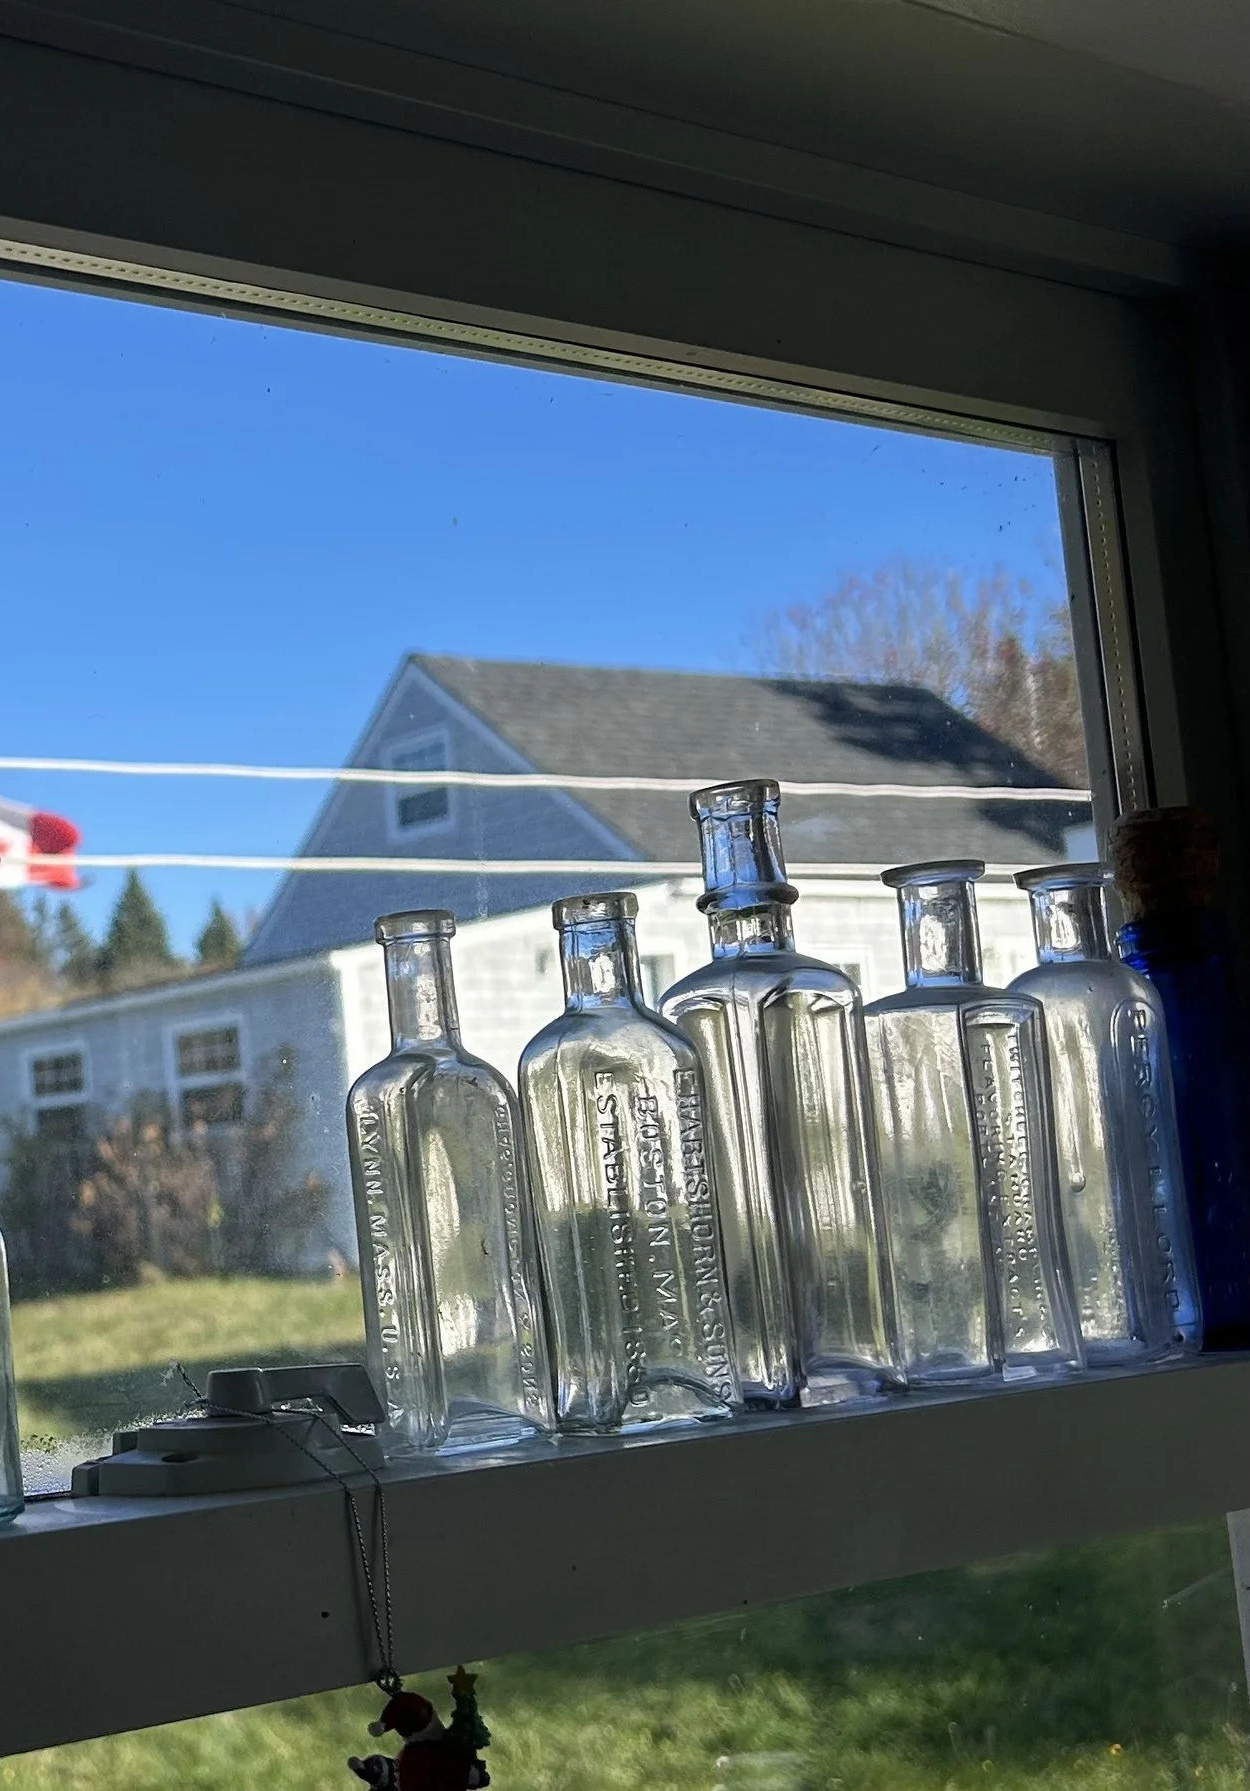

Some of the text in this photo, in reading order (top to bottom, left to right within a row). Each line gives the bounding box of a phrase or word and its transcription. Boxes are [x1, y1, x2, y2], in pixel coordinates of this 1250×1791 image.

[368, 1214, 394, 1319] MASS.
[593, 1071, 640, 1314] ESTABLISHED
[1127, 1008, 1161, 1152] PERCY
[1152, 1204, 1181, 1309] LORD
